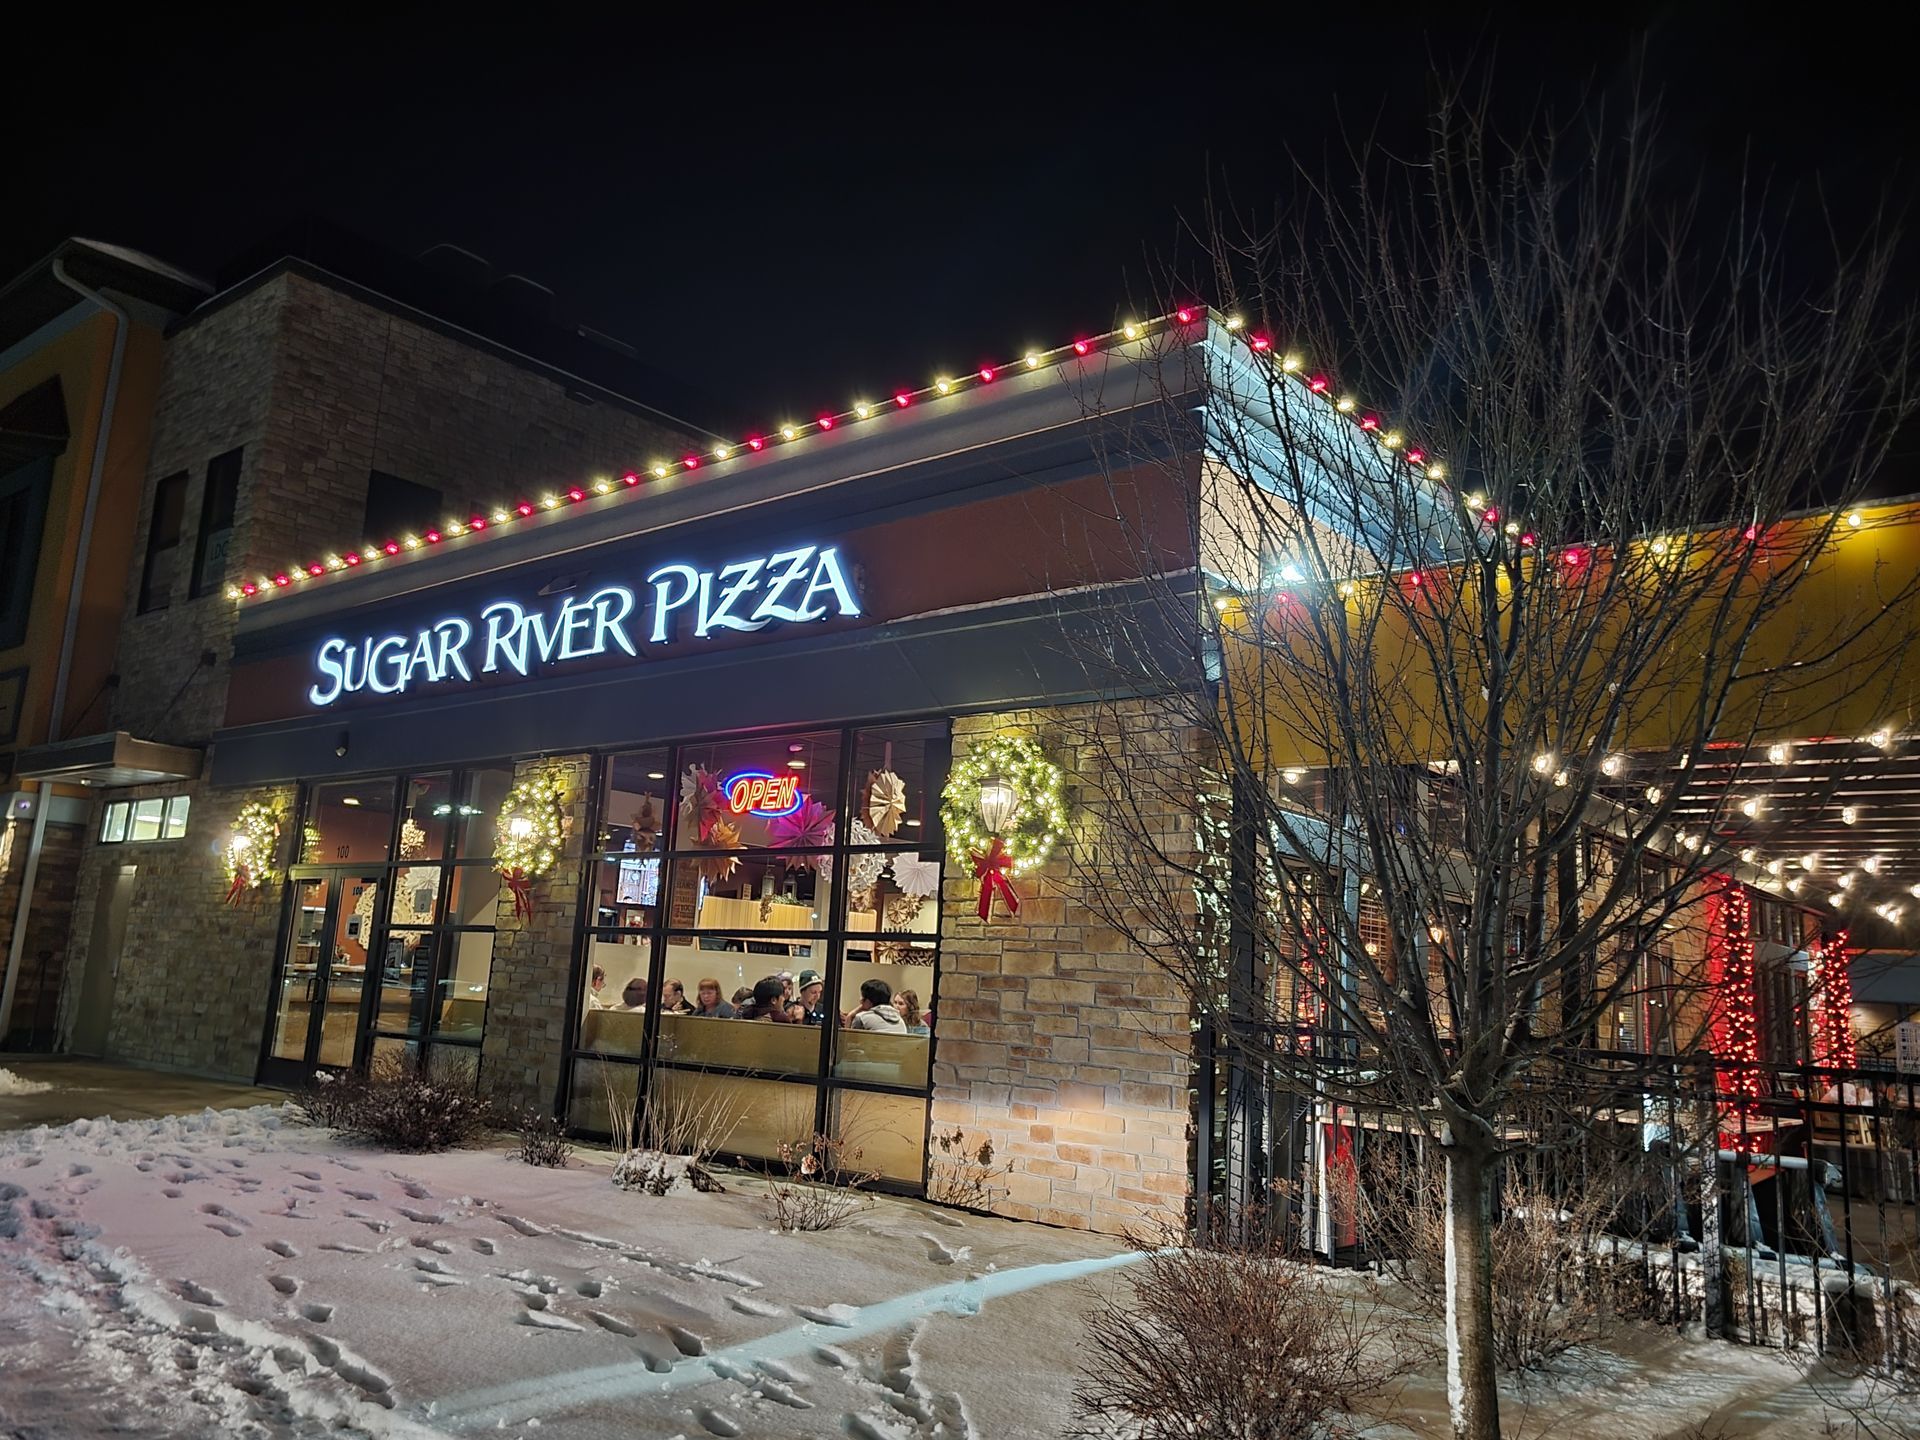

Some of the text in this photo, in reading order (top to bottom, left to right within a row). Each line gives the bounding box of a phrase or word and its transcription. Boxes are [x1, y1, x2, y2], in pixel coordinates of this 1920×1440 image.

[646, 545, 862, 643] PIZZA
[730, 775, 799, 814] OPEN
[337, 844, 350, 859] 100
